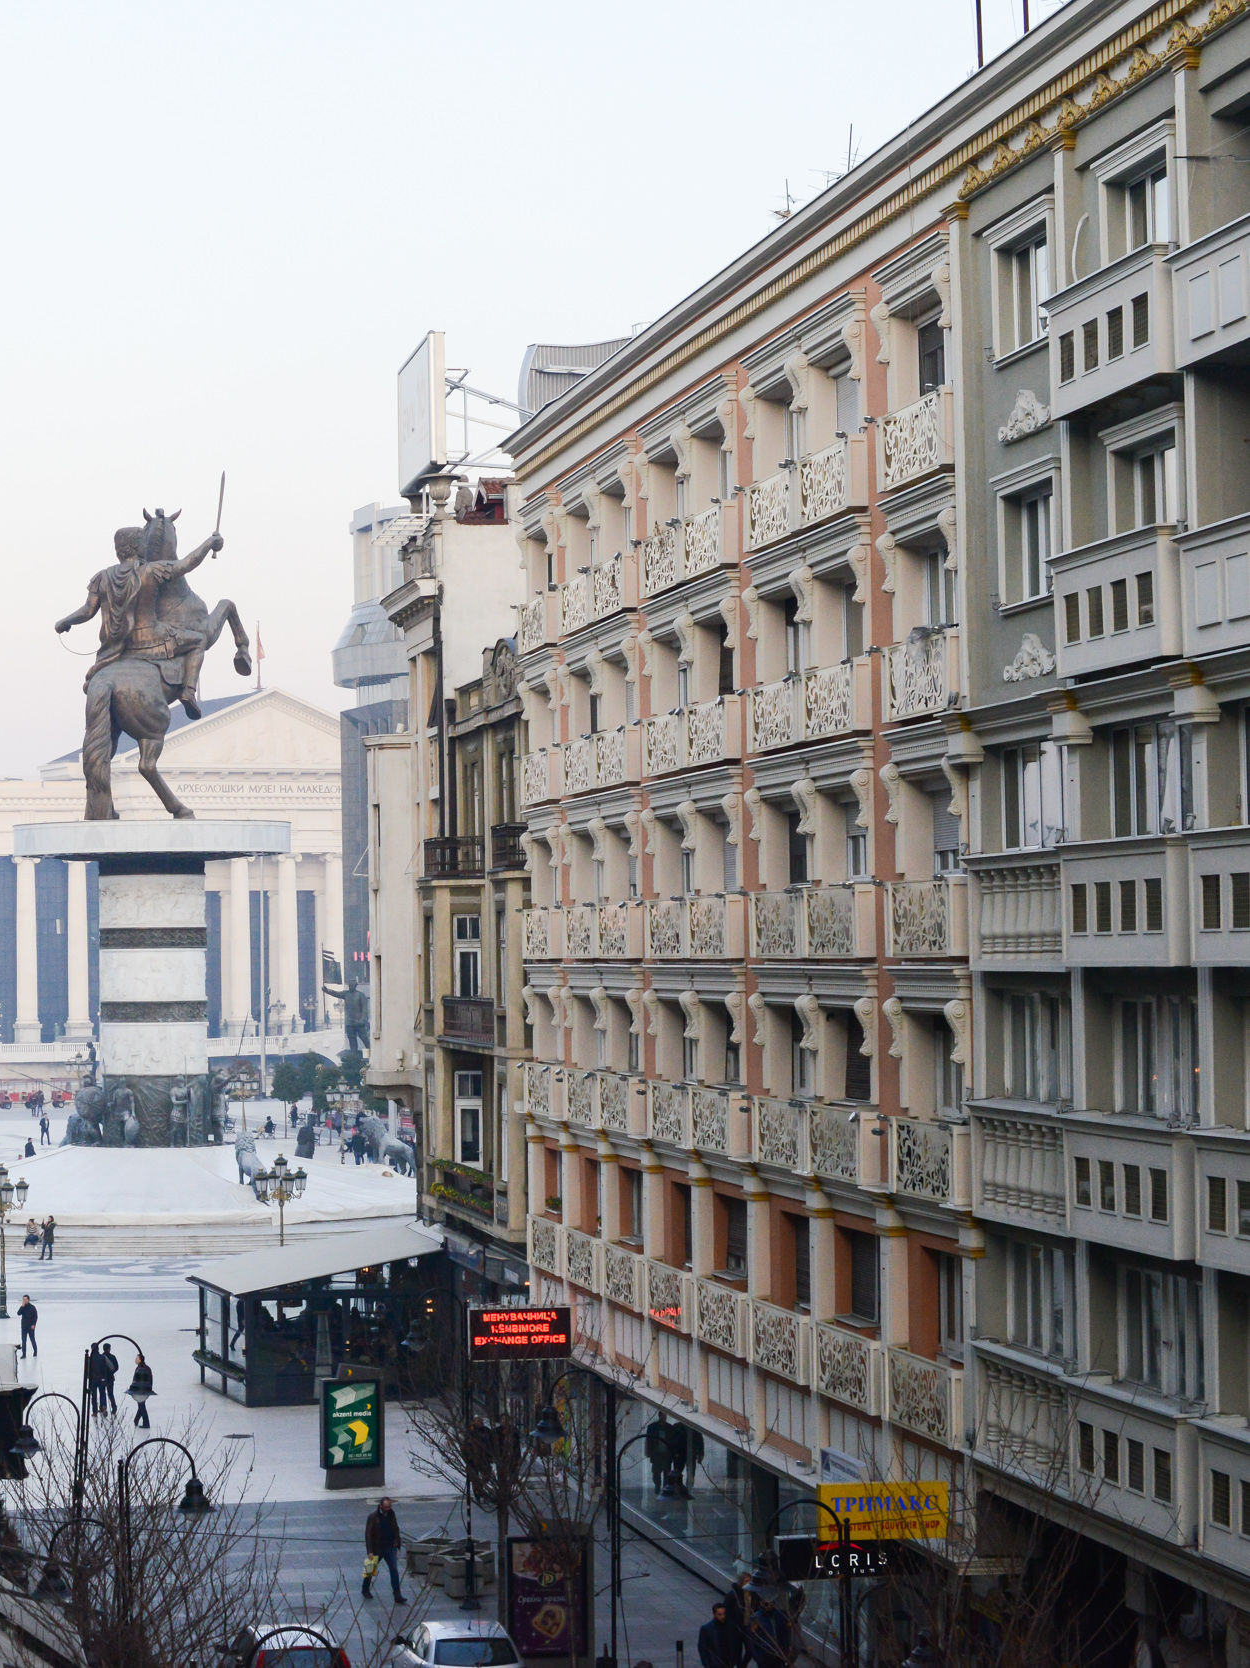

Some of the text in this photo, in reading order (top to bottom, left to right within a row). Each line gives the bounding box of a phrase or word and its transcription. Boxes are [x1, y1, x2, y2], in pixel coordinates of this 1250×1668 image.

[176, 783, 245, 793] АРХЕОЛОШКИ
[279, 784, 294, 793] НА
[530, 1334, 567, 1344] OFFICE
[830, 1495, 938, 1513] ТРИМАКС
